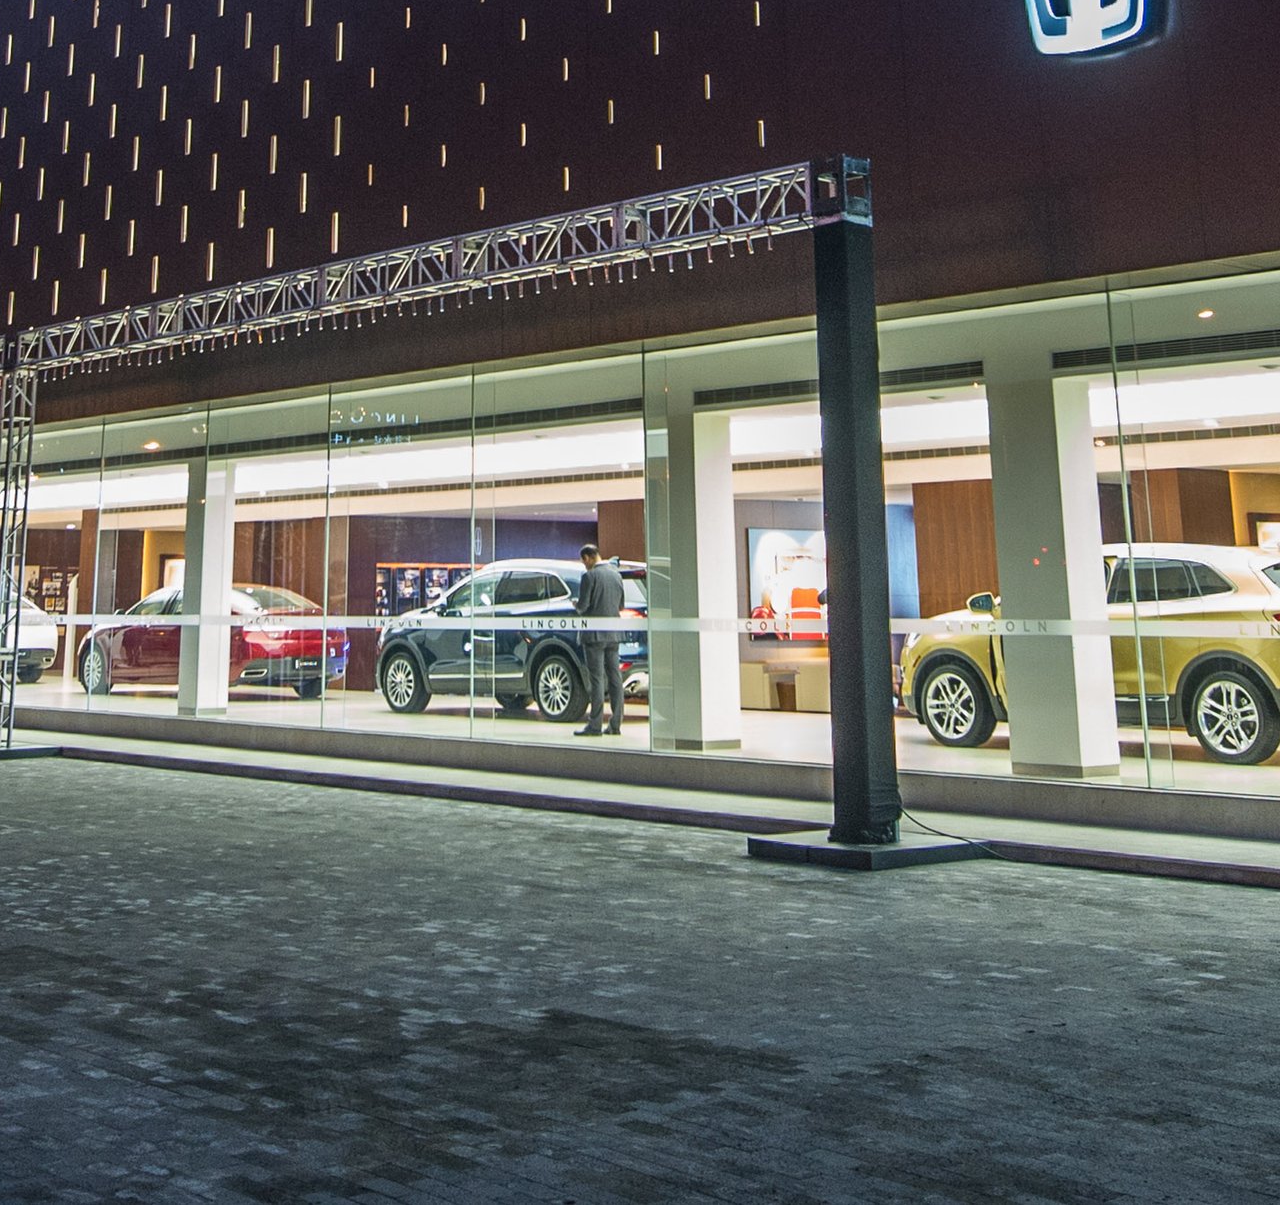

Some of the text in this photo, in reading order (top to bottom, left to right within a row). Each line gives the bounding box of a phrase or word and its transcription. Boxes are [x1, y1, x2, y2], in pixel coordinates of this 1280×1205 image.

[367, 619, 422, 627] LINCOLN
[522, 620, 587, 629] LINCOLN
[945, 621, 1047, 633] LINCOLN
